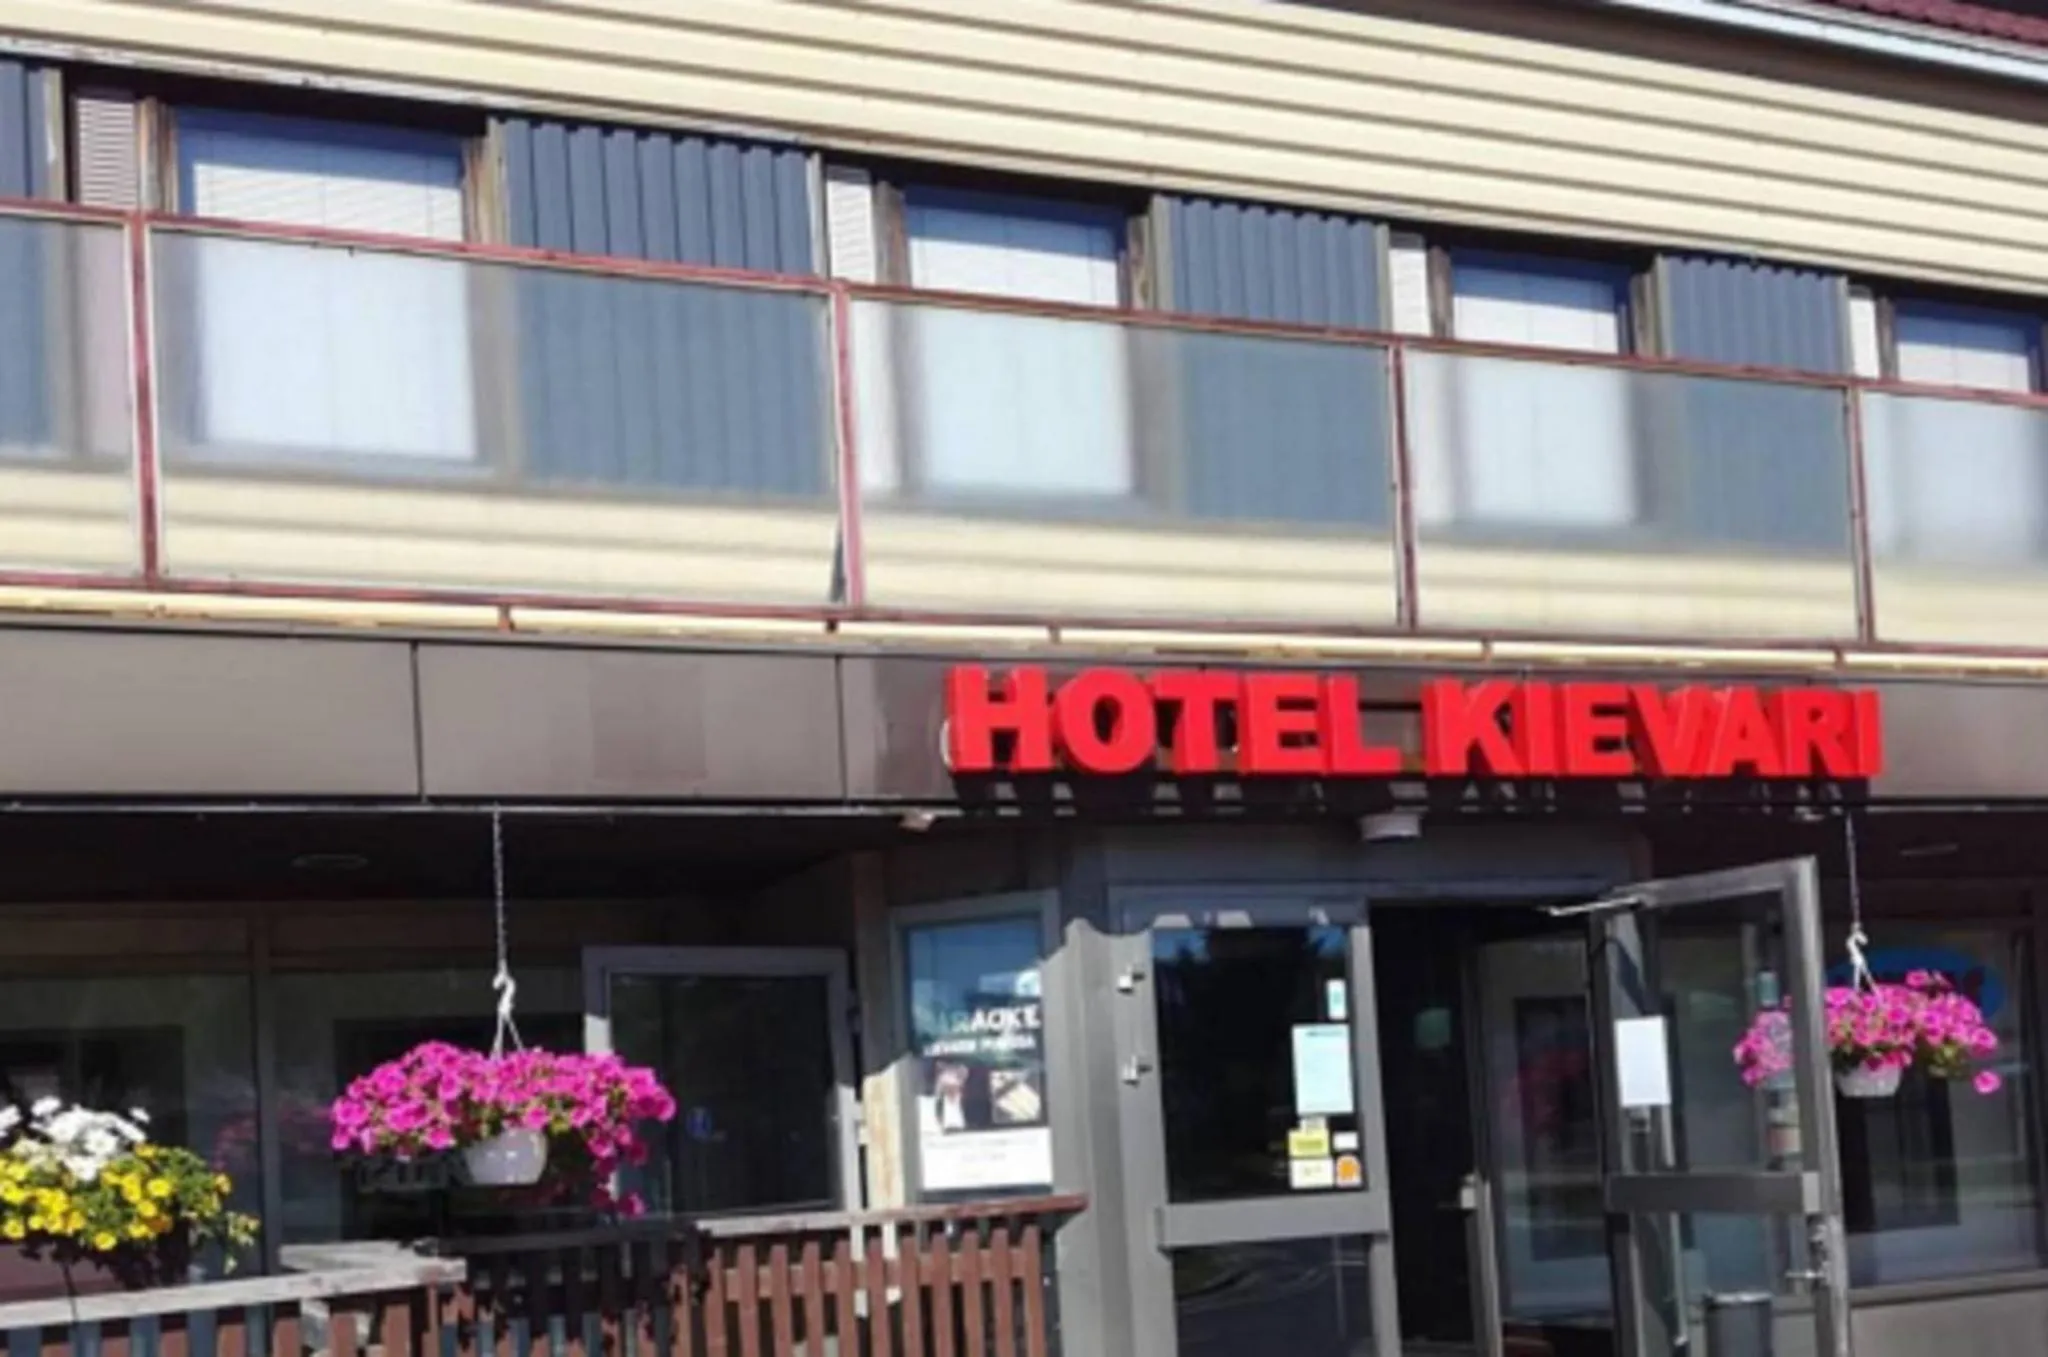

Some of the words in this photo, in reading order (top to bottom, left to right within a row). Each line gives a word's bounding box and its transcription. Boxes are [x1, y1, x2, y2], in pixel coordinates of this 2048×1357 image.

[948, 665, 1402, 775] HOTEL
[1422, 677, 1881, 778] KIEVARI
[919, 1003, 1042, 1037] ARAOKE
